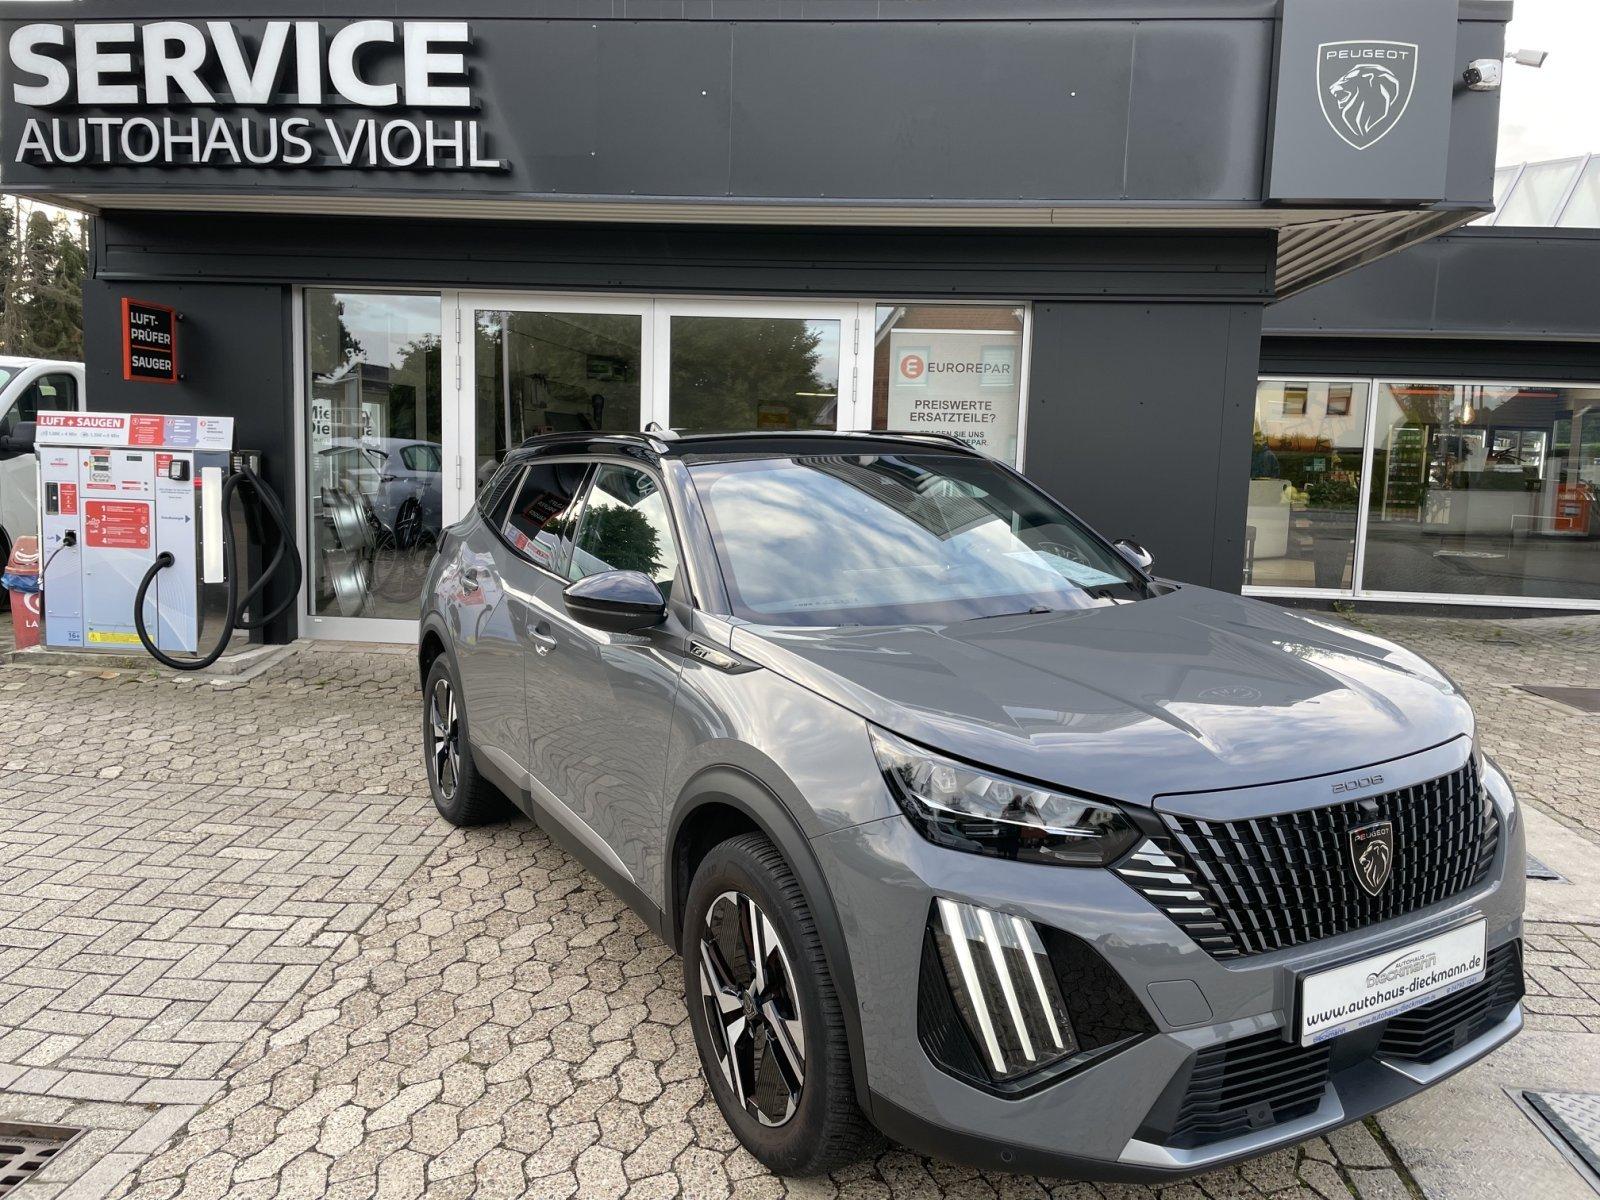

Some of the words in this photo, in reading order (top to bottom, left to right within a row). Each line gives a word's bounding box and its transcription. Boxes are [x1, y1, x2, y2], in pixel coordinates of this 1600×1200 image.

[1326, 49, 1409, 60] PEUGEOT
[8, 20, 471, 106] SERVICE
[15, 117, 313, 164] AUTOHAUS
[325, 119, 501, 167] VIOHL
[130, 312, 158, 325] LUFT-
[131, 328, 170, 344] PRÜFER
[132, 355, 171, 370] SAUGER
[928, 362, 1011, 374] EUROREPAR
[914, 400, 992, 411] PREISWERTE
[40, 416, 66, 426] LUFT
[76, 418, 121, 427] SAUGEN
[910, 412, 996, 423] ERSATZTEILE?
[1331, 775, 1384, 793] 2008
[1354, 828, 1390, 841] PEUGEOT
[1395, 954, 1425, 968] AUTOHAUS
[1306, 955, 1481, 1027] www.autohaus-dieckmann.de
